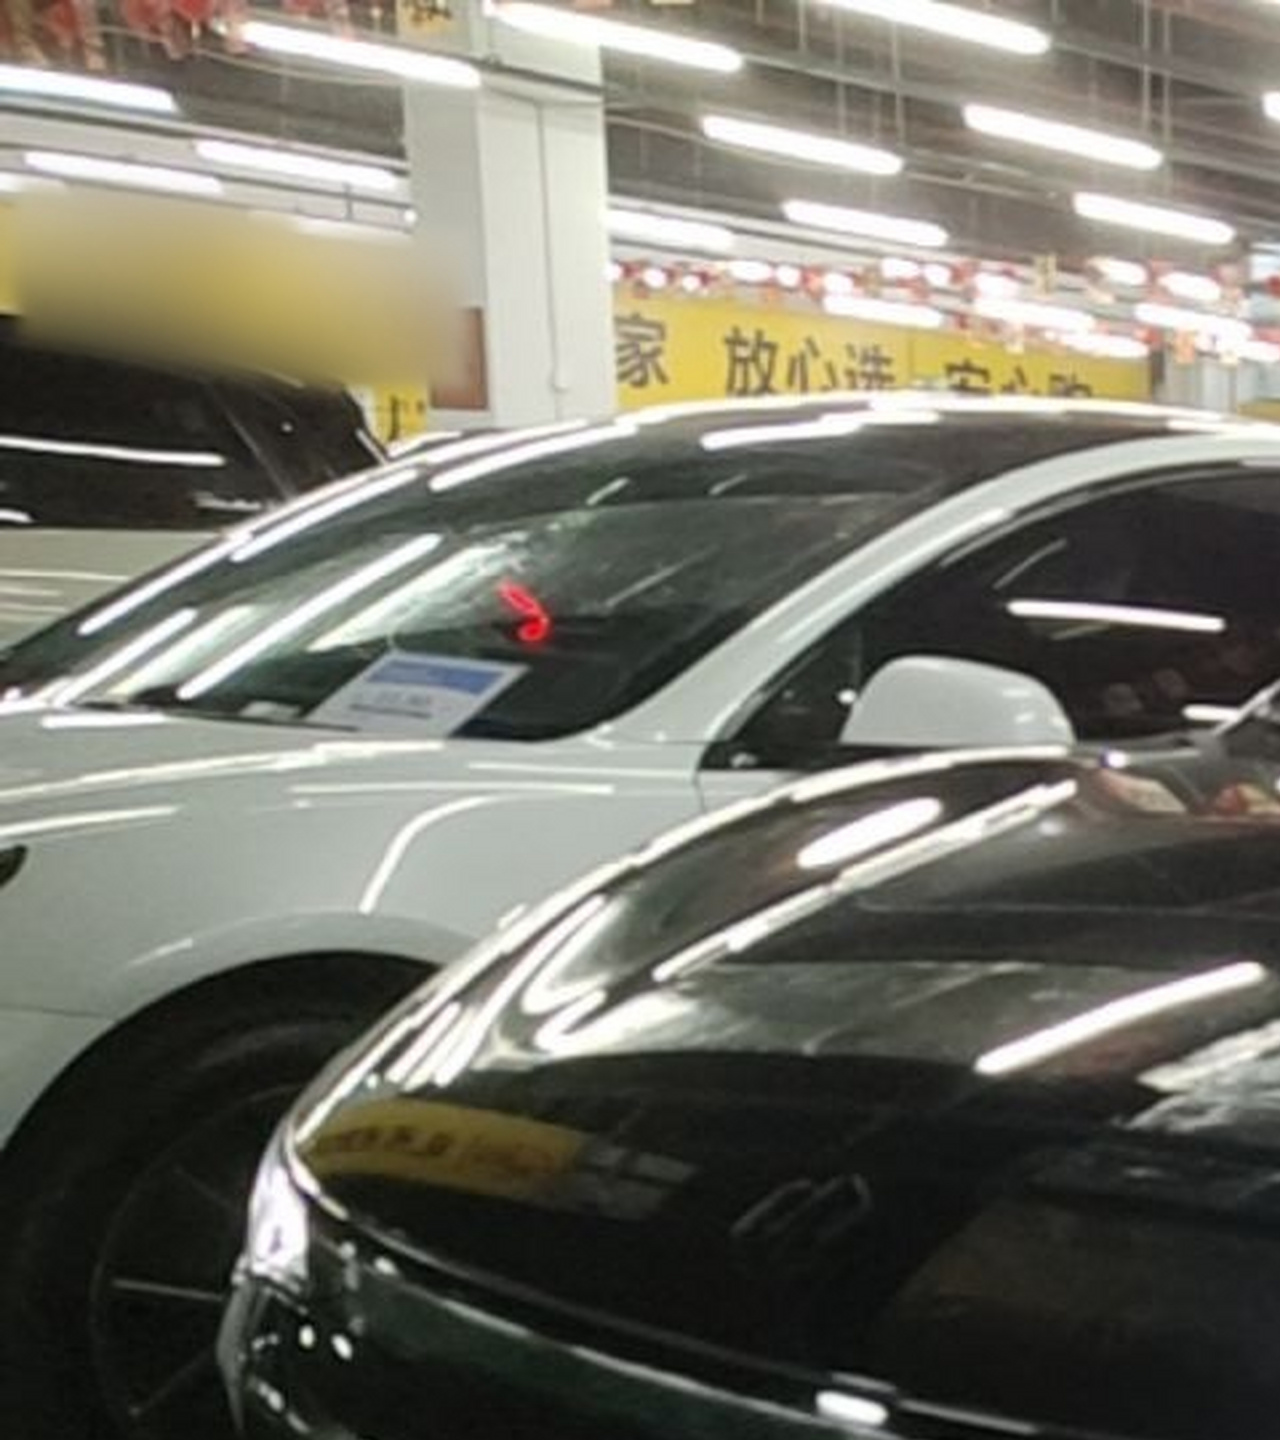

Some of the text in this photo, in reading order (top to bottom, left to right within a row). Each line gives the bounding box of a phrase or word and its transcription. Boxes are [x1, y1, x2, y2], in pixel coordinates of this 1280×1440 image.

[613, 312, 668, 388] 家
[724, 325, 895, 396] 放心选
